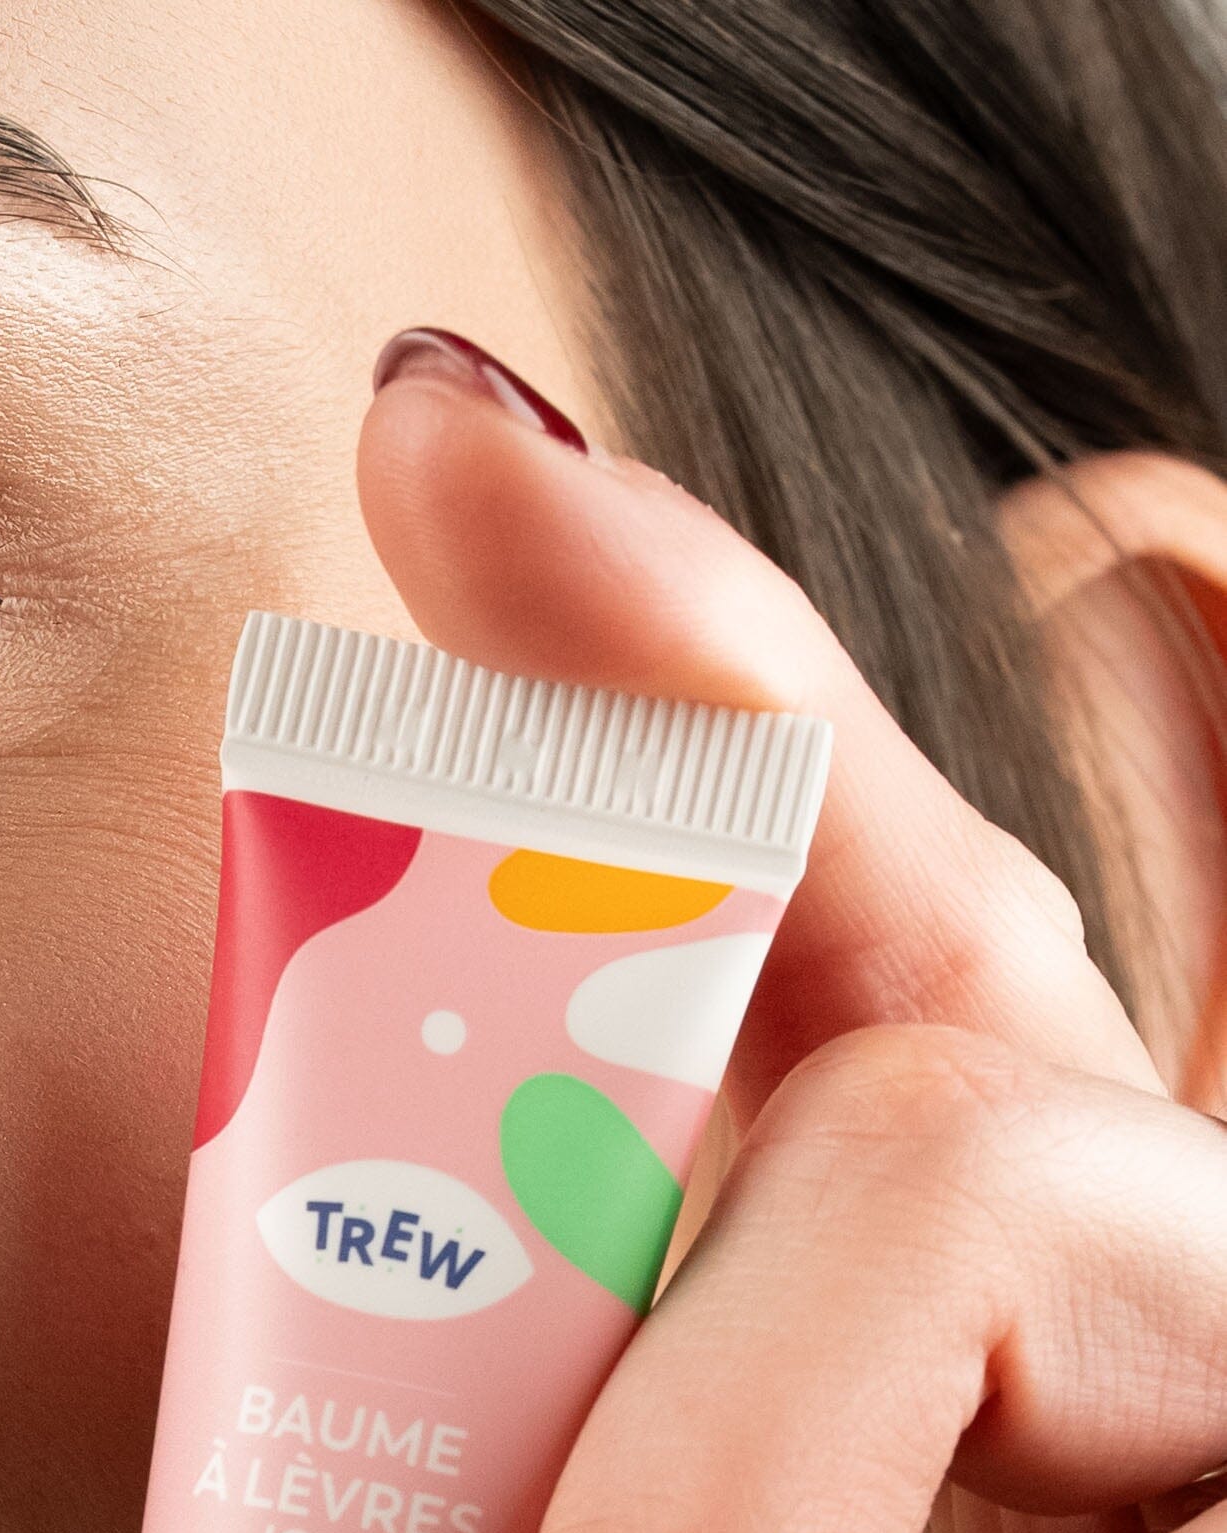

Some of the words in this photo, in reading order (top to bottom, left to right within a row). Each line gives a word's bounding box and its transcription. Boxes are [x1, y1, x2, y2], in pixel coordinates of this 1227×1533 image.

[306, 1201, 486, 1290] TREW
[193, 1438, 226, 1500] À
[237, 1385, 468, 1476] BAUME
